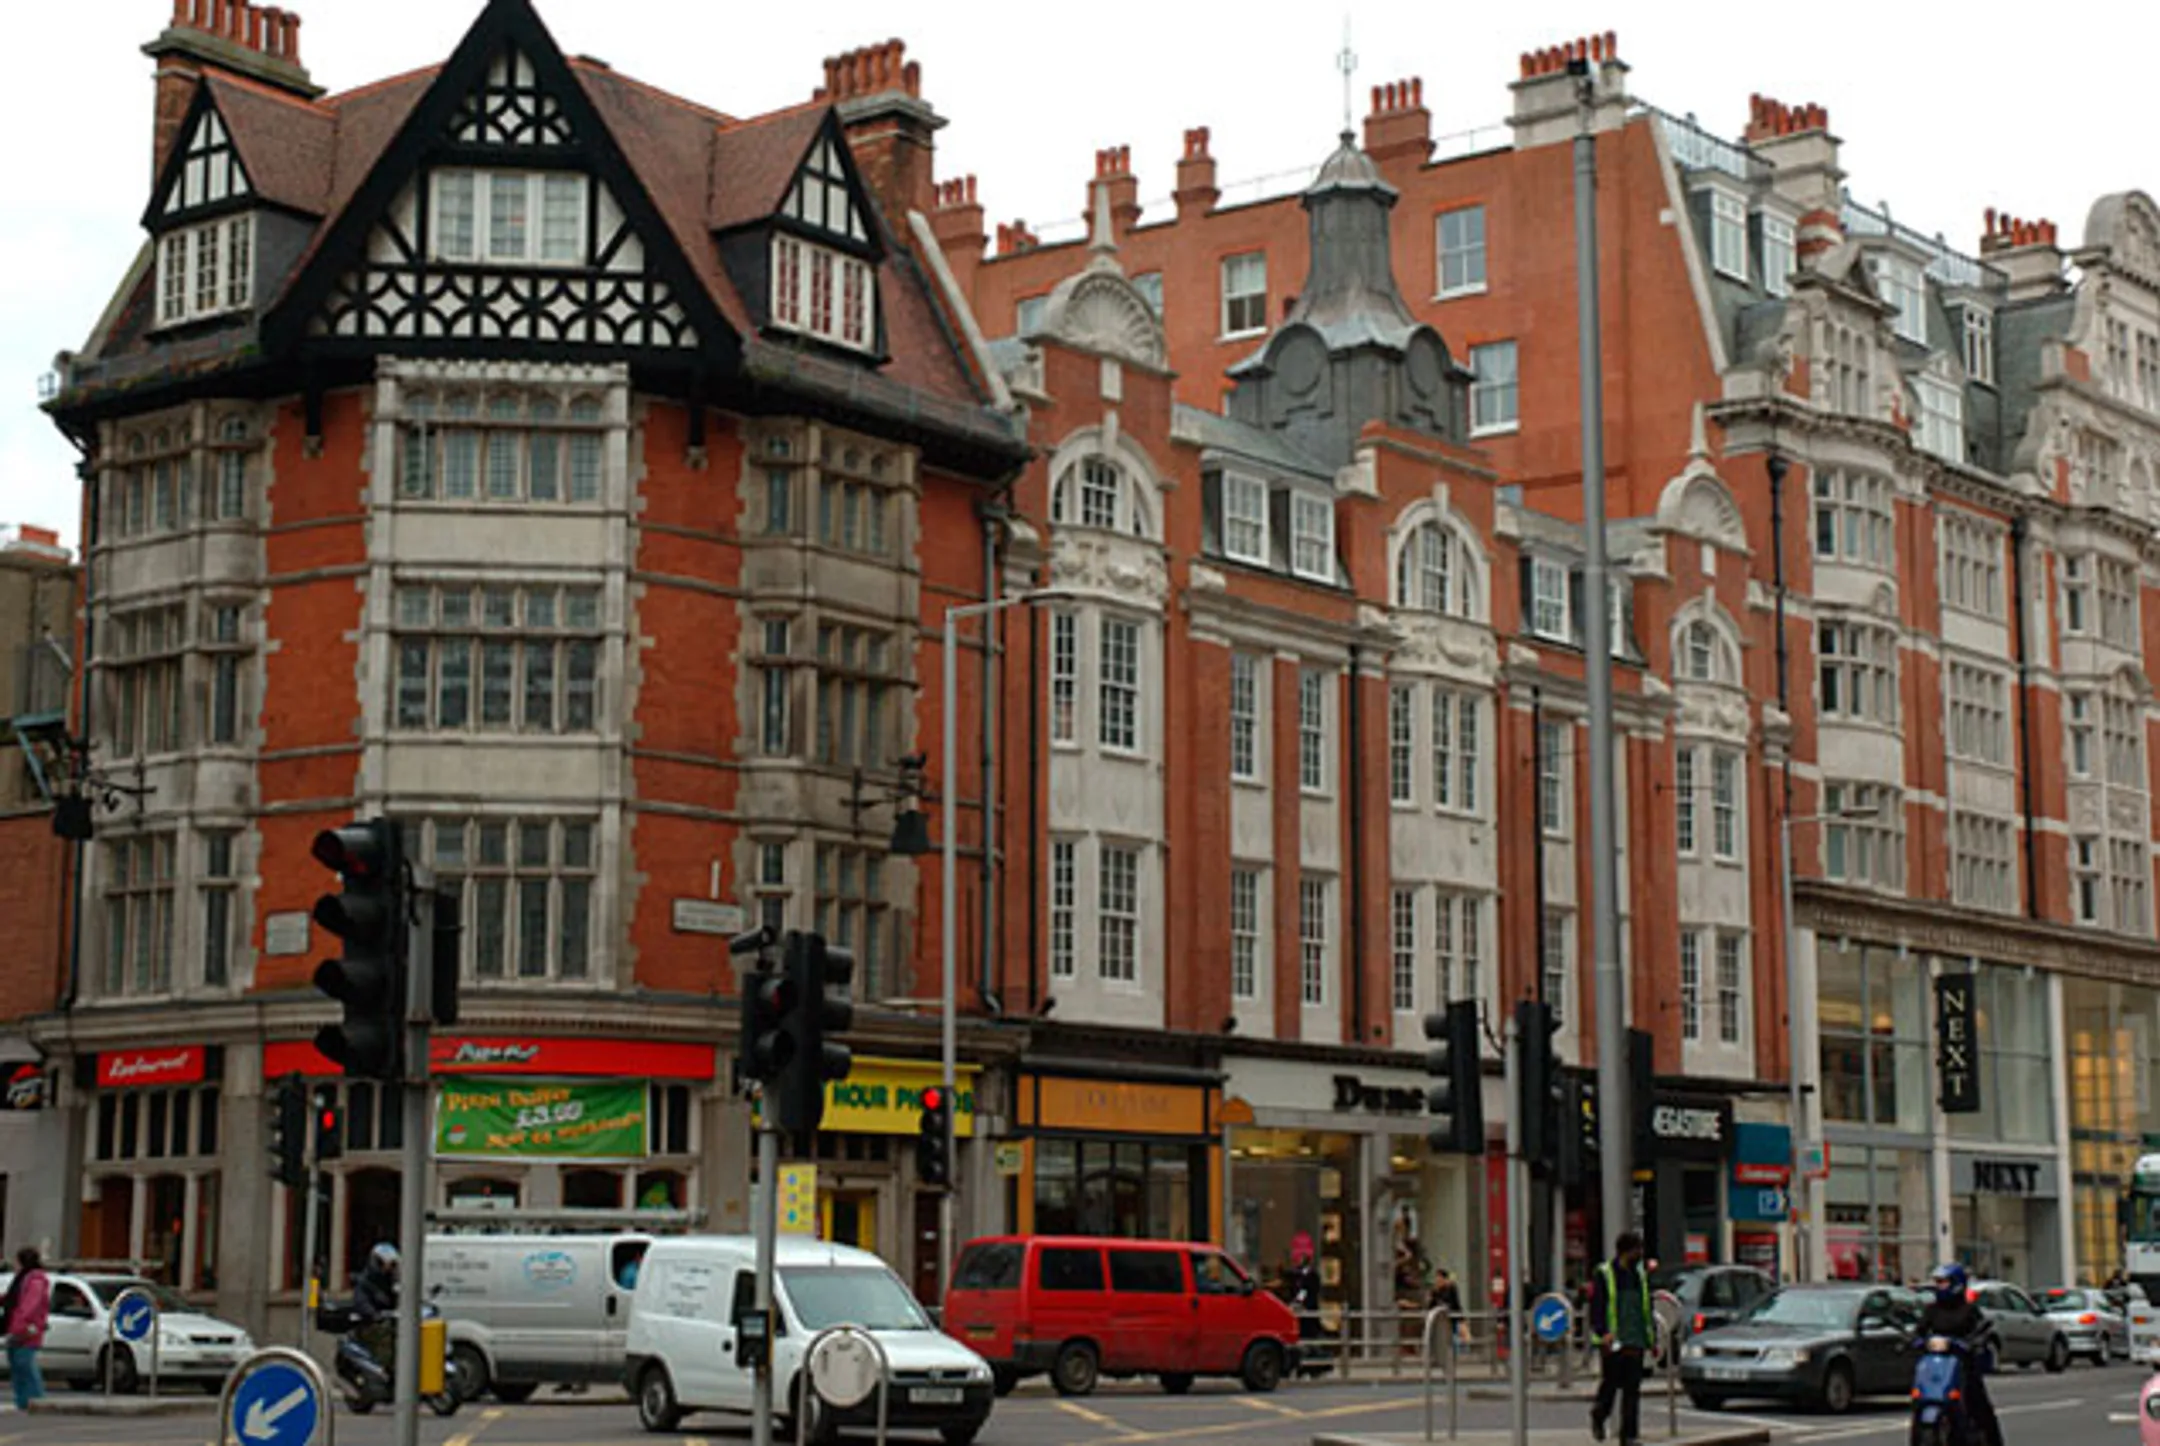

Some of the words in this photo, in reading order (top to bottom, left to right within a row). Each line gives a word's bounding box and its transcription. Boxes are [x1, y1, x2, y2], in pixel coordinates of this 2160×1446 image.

[1942, 989, 1967, 1096] NEXT
[833, 1083, 889, 1109] HOUR
[1972, 1160, 2040, 1193] NEXT
